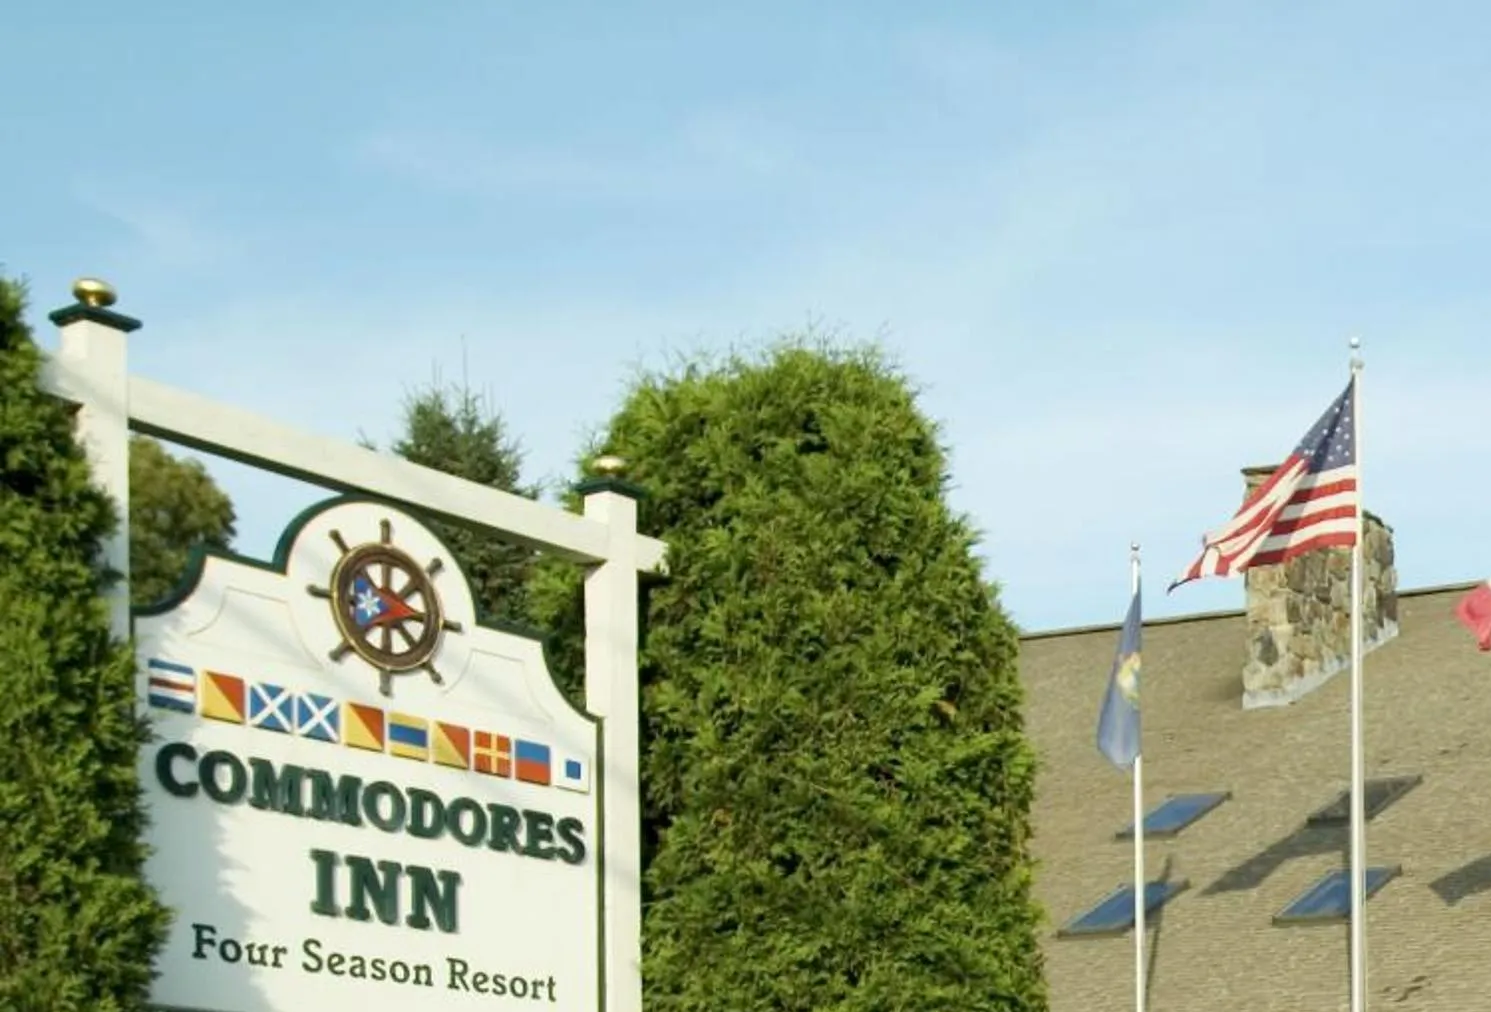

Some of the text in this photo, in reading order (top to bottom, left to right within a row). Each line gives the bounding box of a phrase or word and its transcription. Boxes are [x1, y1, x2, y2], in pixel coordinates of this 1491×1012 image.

[155, 741, 587, 865] COMMODORES
[309, 848, 463, 933] INN
[191, 923, 557, 1002] Four Season Resort
